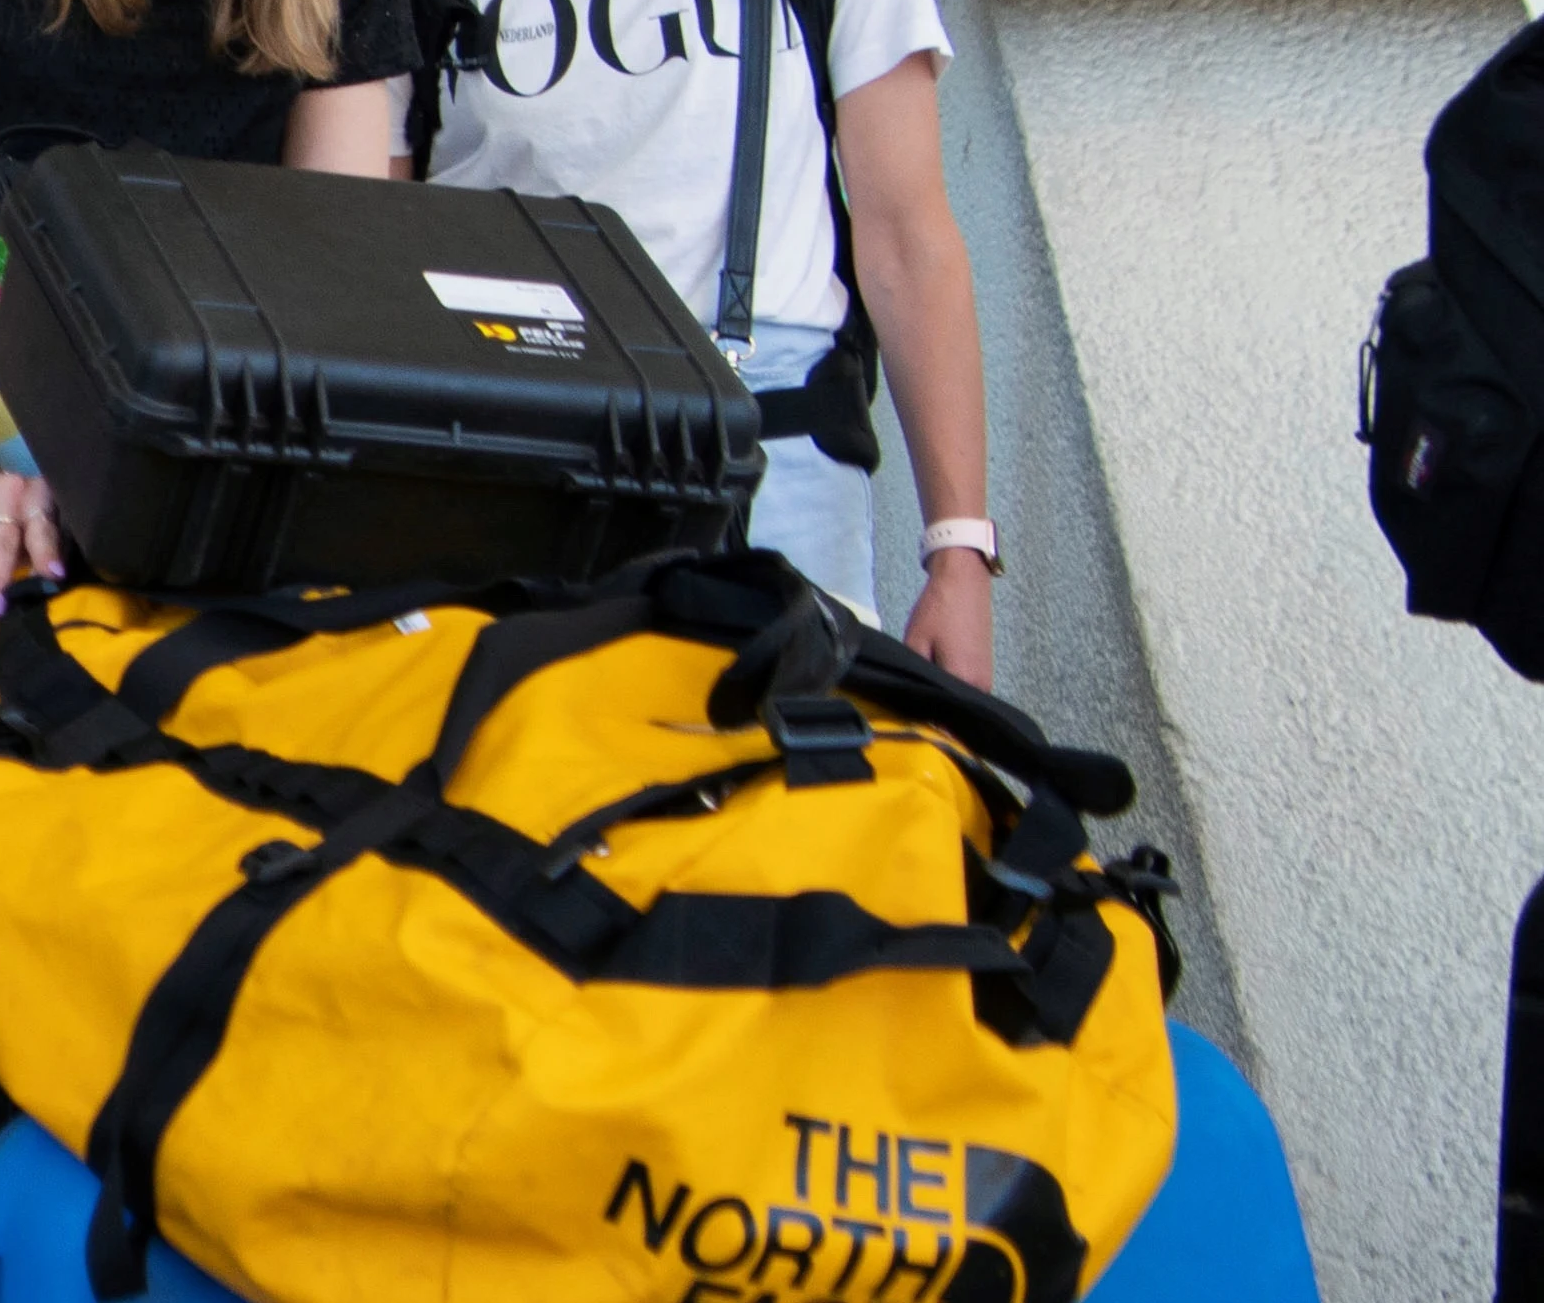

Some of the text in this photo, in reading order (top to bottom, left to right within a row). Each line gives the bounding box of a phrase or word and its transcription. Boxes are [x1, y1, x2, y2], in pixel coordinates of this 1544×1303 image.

[498, 21, 555, 43] NEDERLAND
[784, 1112, 954, 1225] THE
[603, 1159, 956, 1295] NORTH
